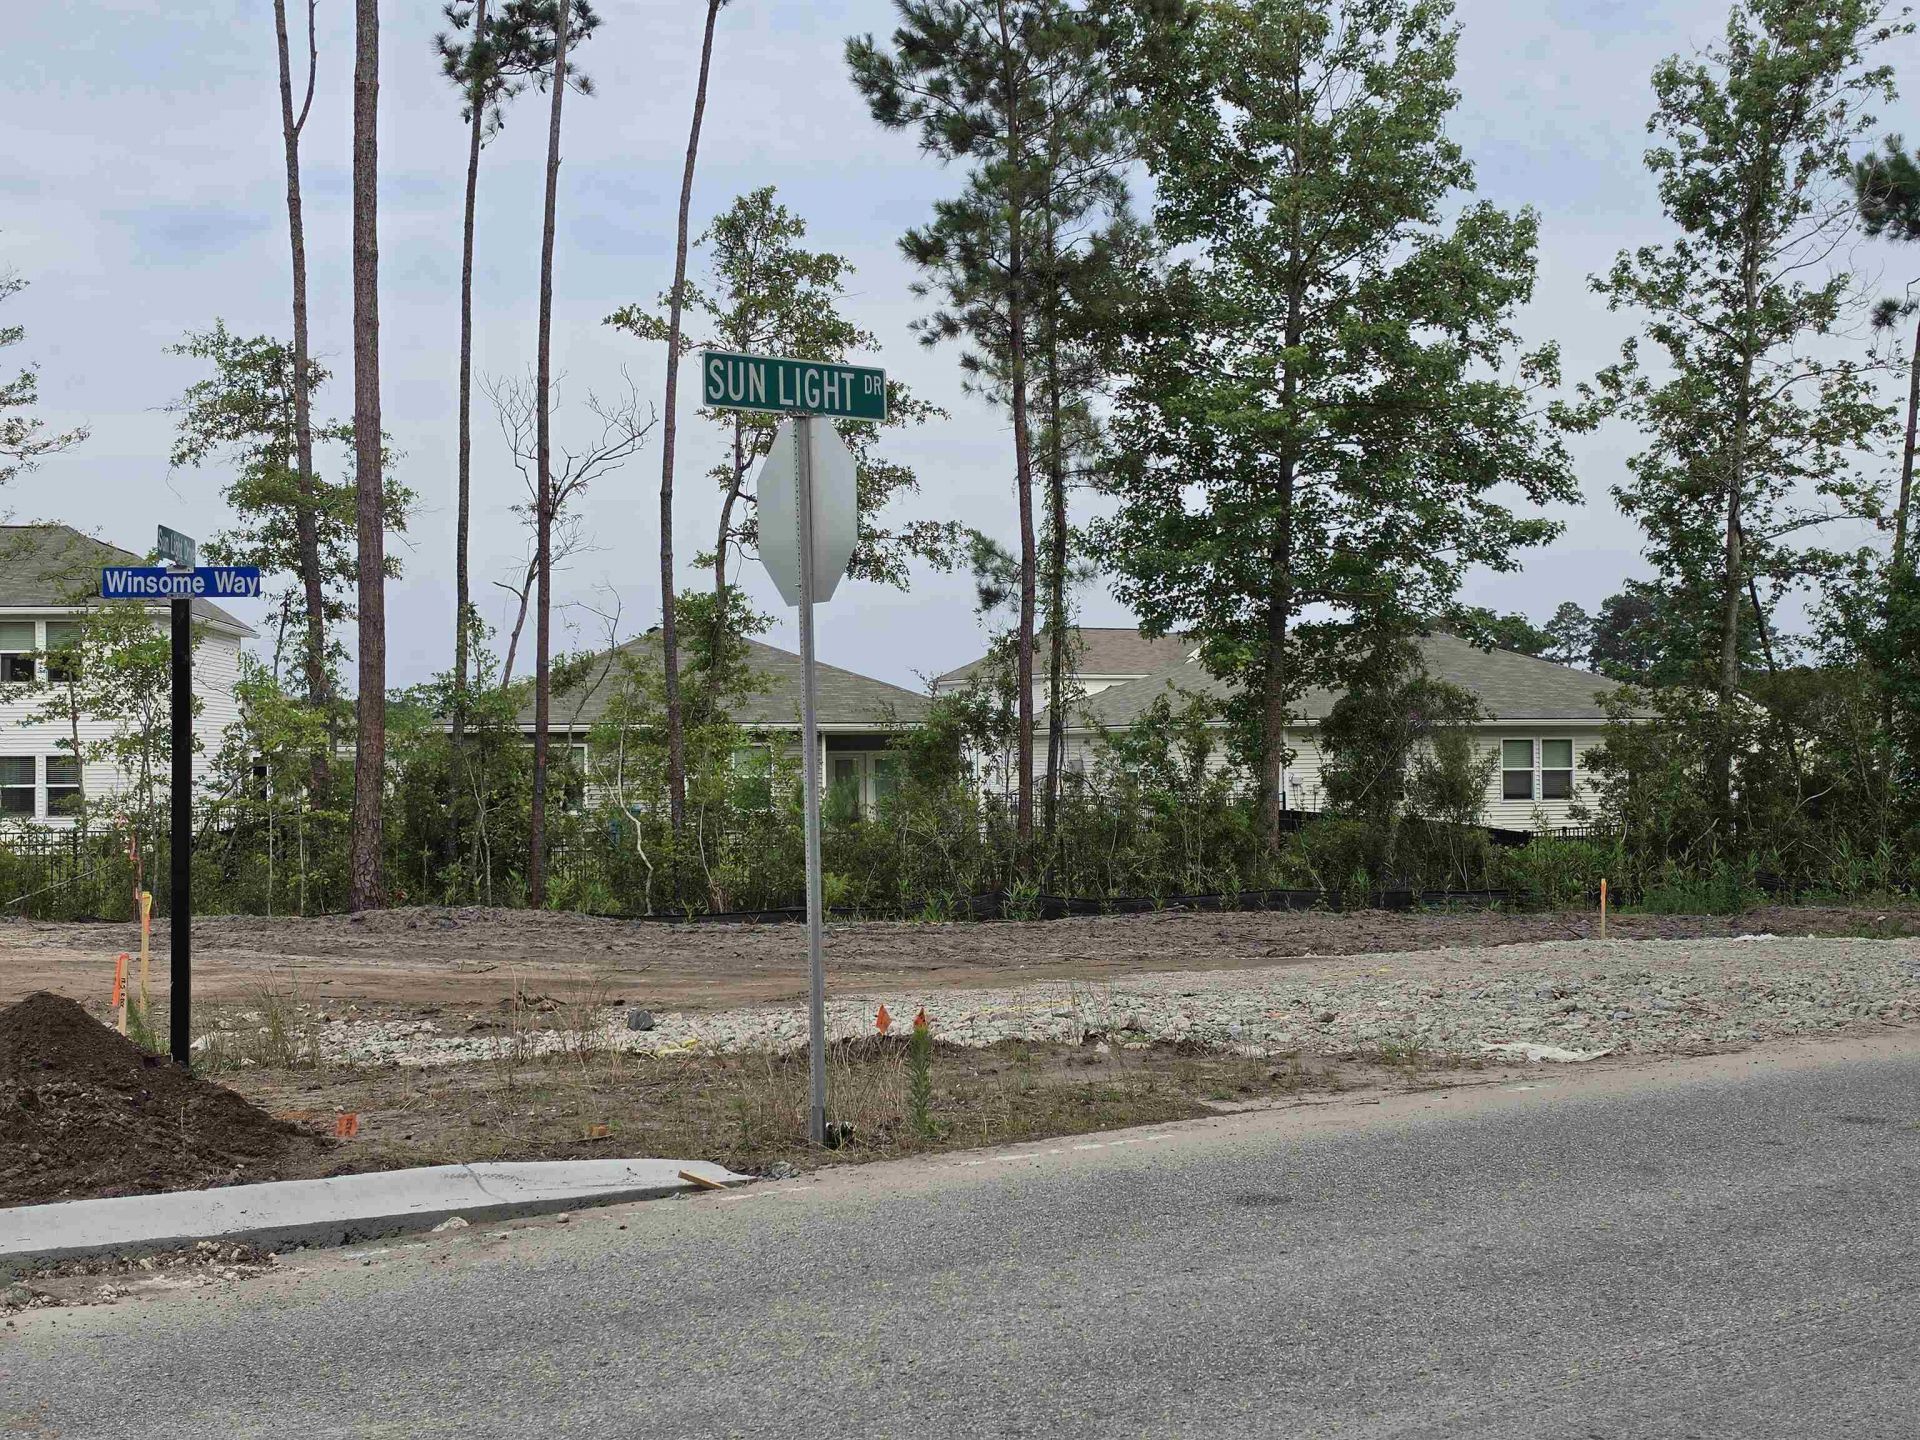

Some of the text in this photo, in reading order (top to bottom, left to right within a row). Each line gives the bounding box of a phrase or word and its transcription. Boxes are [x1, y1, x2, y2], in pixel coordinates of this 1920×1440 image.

[708, 358, 882, 411] SUN LIGHT DR
[106, 570, 259, 597] Winsome Way
